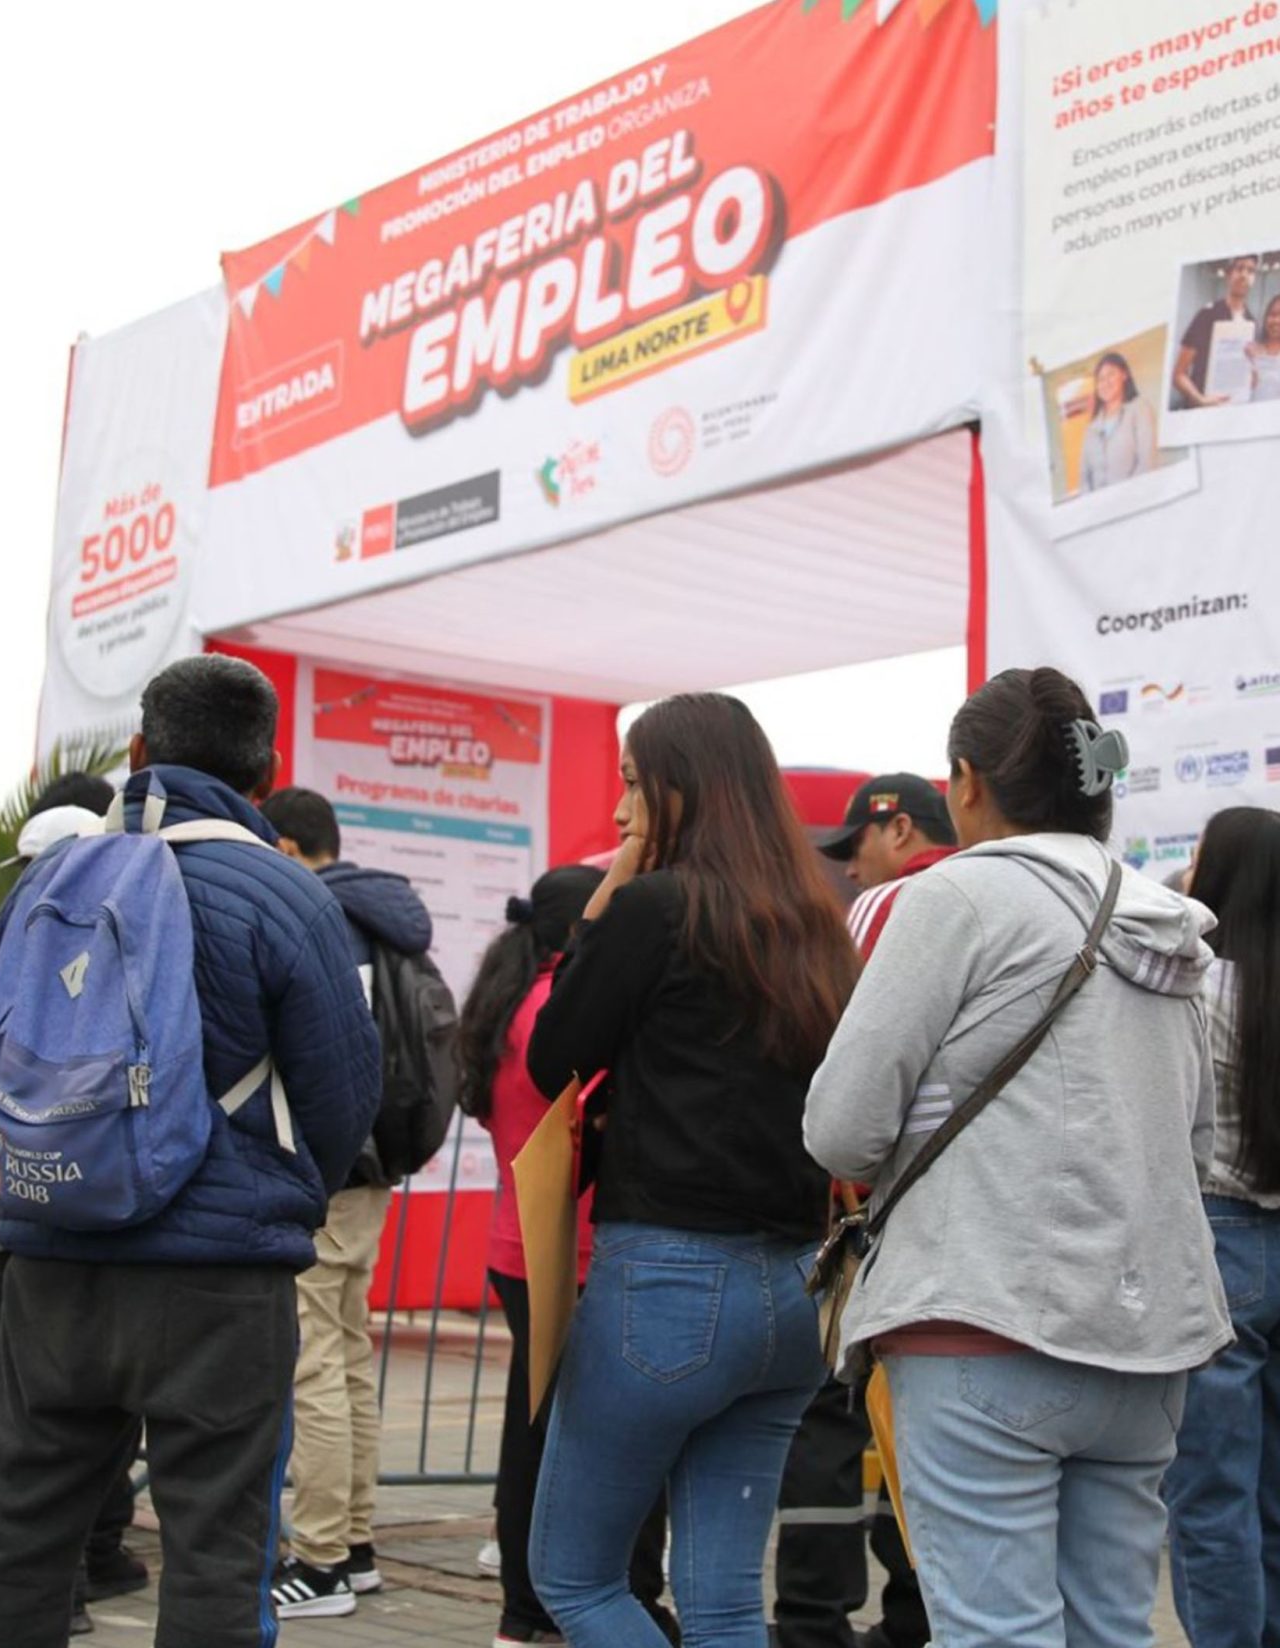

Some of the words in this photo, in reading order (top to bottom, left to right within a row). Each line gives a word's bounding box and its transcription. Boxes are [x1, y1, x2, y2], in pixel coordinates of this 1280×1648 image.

[1087, 50, 1143, 83] eres
[1148, 14, 1238, 61] mayor
[1242, 1, 1278, 28] de
[1054, 94, 1115, 130] años
[1119, 81, 1147, 105] te
[1151, 36, 1280, 93] esperam
[418, 131, 522, 196] MINISTERIO
[523, 118, 552, 148] DE
[554, 72, 649, 132] TRABAJO
[650, 64, 668, 86] Y
[1072, 114, 1187, 168] Encontrarás
[1188, 90, 1263, 128] ofertas
[1265, 82, 1280, 101] d
[381, 178, 486, 243] PROMOCIÓN
[487, 163, 525, 196] DEL
[526, 126, 606, 178] EMPLEO
[607, 77, 711, 141] ORGANIZA
[1063, 162, 1132, 198] empleo
[1134, 149, 1179, 179] para
[360, 179, 598, 339] MEGAFERIA
[605, 130, 696, 212] DEL
[1051, 190, 1136, 234] personas
[1138, 178, 1176, 205] con
[1063, 224, 1122, 255] adulto
[1125, 203, 1188, 238] mayor
[1189, 201, 1203, 218] y
[403, 166, 767, 413] EMPLEO
[579, 340, 633, 385] LIMA
[634, 311, 712, 362] NORTE
[236, 362, 335, 430] ENTRADA
[80, 501, 176, 583] 5000
[1096, 592, 1250, 637] Coorganizan:
[390, 734, 491, 767] EMPLEO
[335, 773, 429, 802] Programa
[5, 1153, 84, 1184] RUSSIA
[5, 1175, 51, 1204] 2018
[43, 1150, 63, 1161] CUP
